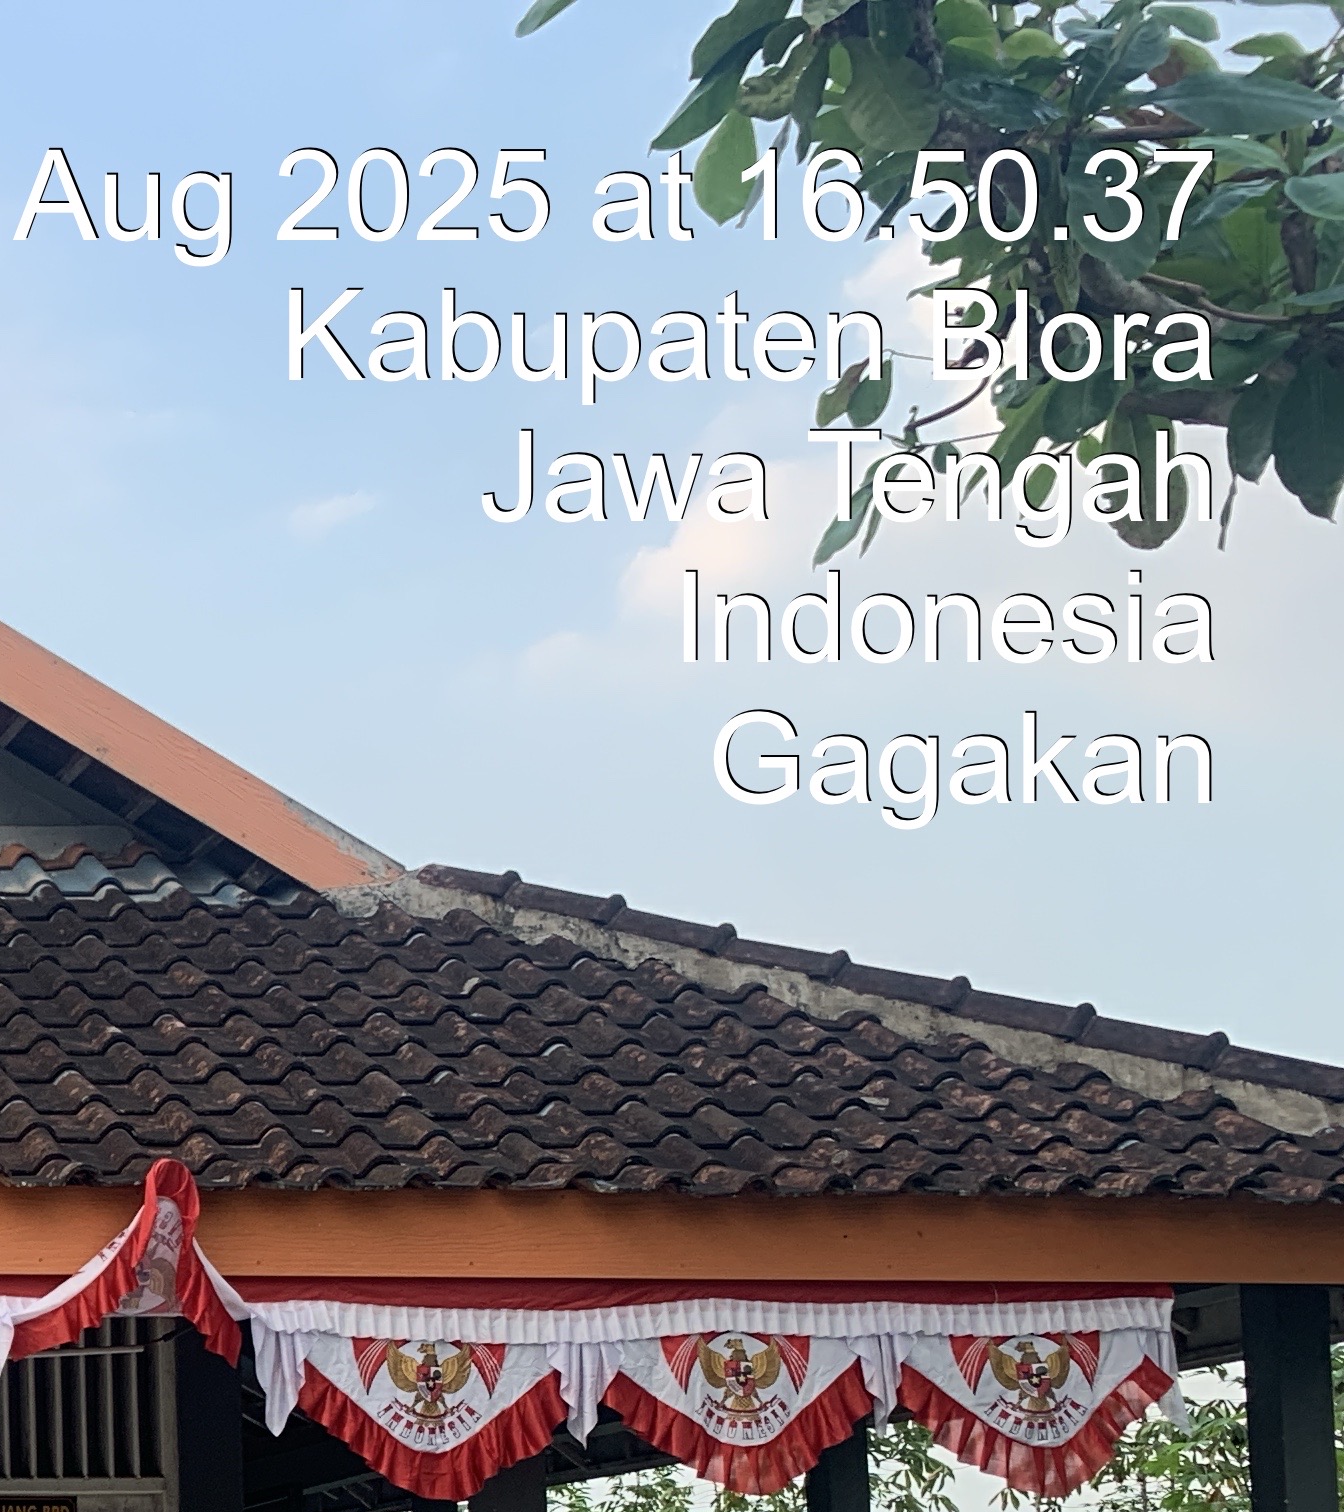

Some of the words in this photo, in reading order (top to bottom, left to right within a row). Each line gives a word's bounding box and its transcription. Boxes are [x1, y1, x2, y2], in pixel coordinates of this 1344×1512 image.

[376, 1402, 484, 1446] INDONESIA
[694, 1400, 791, 1440] INDONESIA
[983, 1399, 1089, 1441] INDONESIA
